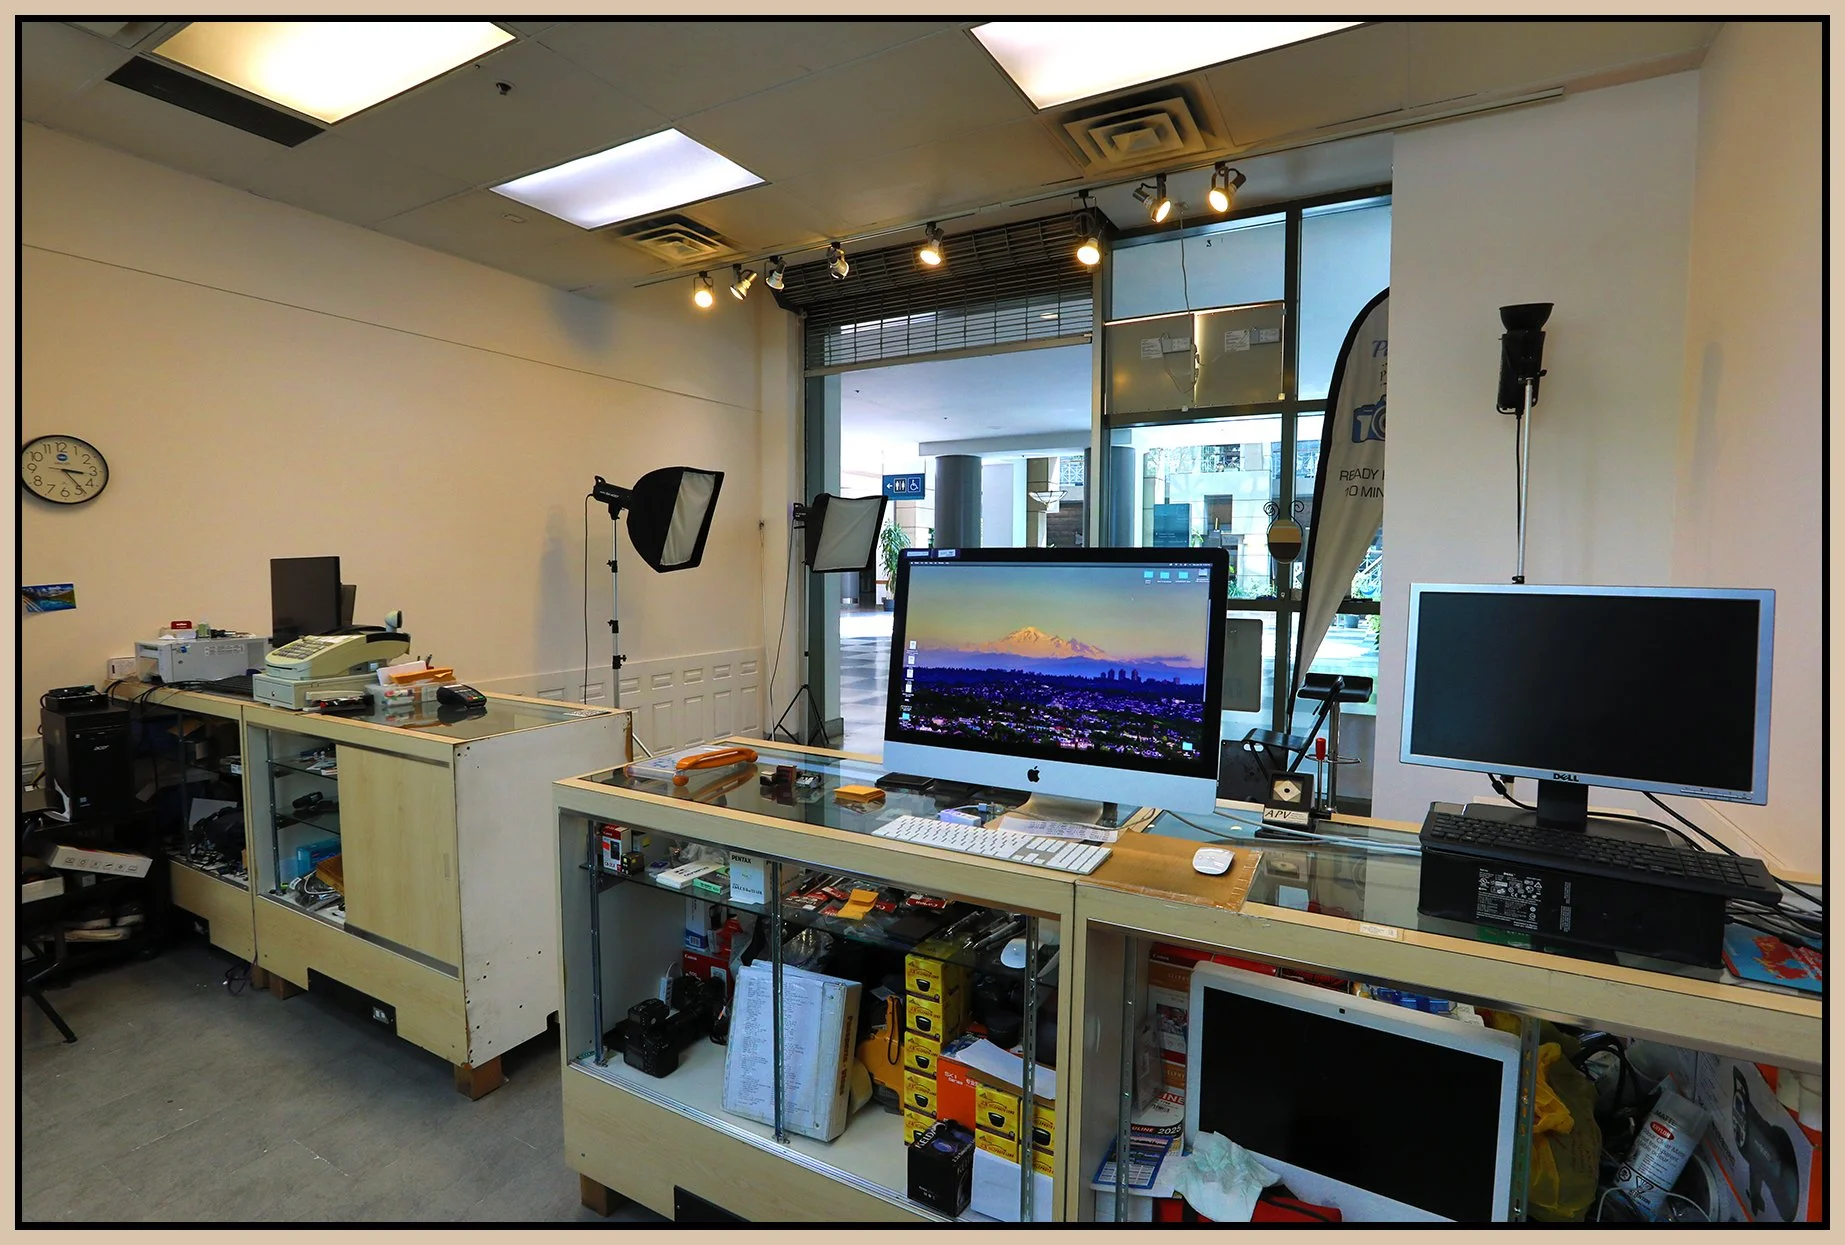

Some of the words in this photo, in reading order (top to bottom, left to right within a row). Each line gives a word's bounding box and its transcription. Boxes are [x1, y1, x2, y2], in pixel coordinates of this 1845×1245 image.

[43, 444, 51, 454] 11
[55, 441, 68, 453] 12
[30, 451, 43, 462] 10
[81, 453, 91, 465] 2
[27, 462, 38, 473] 9
[88, 466, 98, 477] 3
[1339, 467, 1379, 481] READY
[33, 475, 43, 487] 8
[85, 478, 94, 487] 4
[47, 484, 56, 494] 7
[60, 487, 71, 498] 6
[75, 485, 84, 496] 5
[1344, 485, 1358, 497] 10
[1553, 773, 1579, 782] DELL
[1264, 809, 1292, 819] APV
[731, 854, 752, 865] PENTAX
[684, 953, 698, 961] Canon
[1131, 1125, 1154, 1133] ULINE
[1157, 1124, 1182, 1135] 2025
